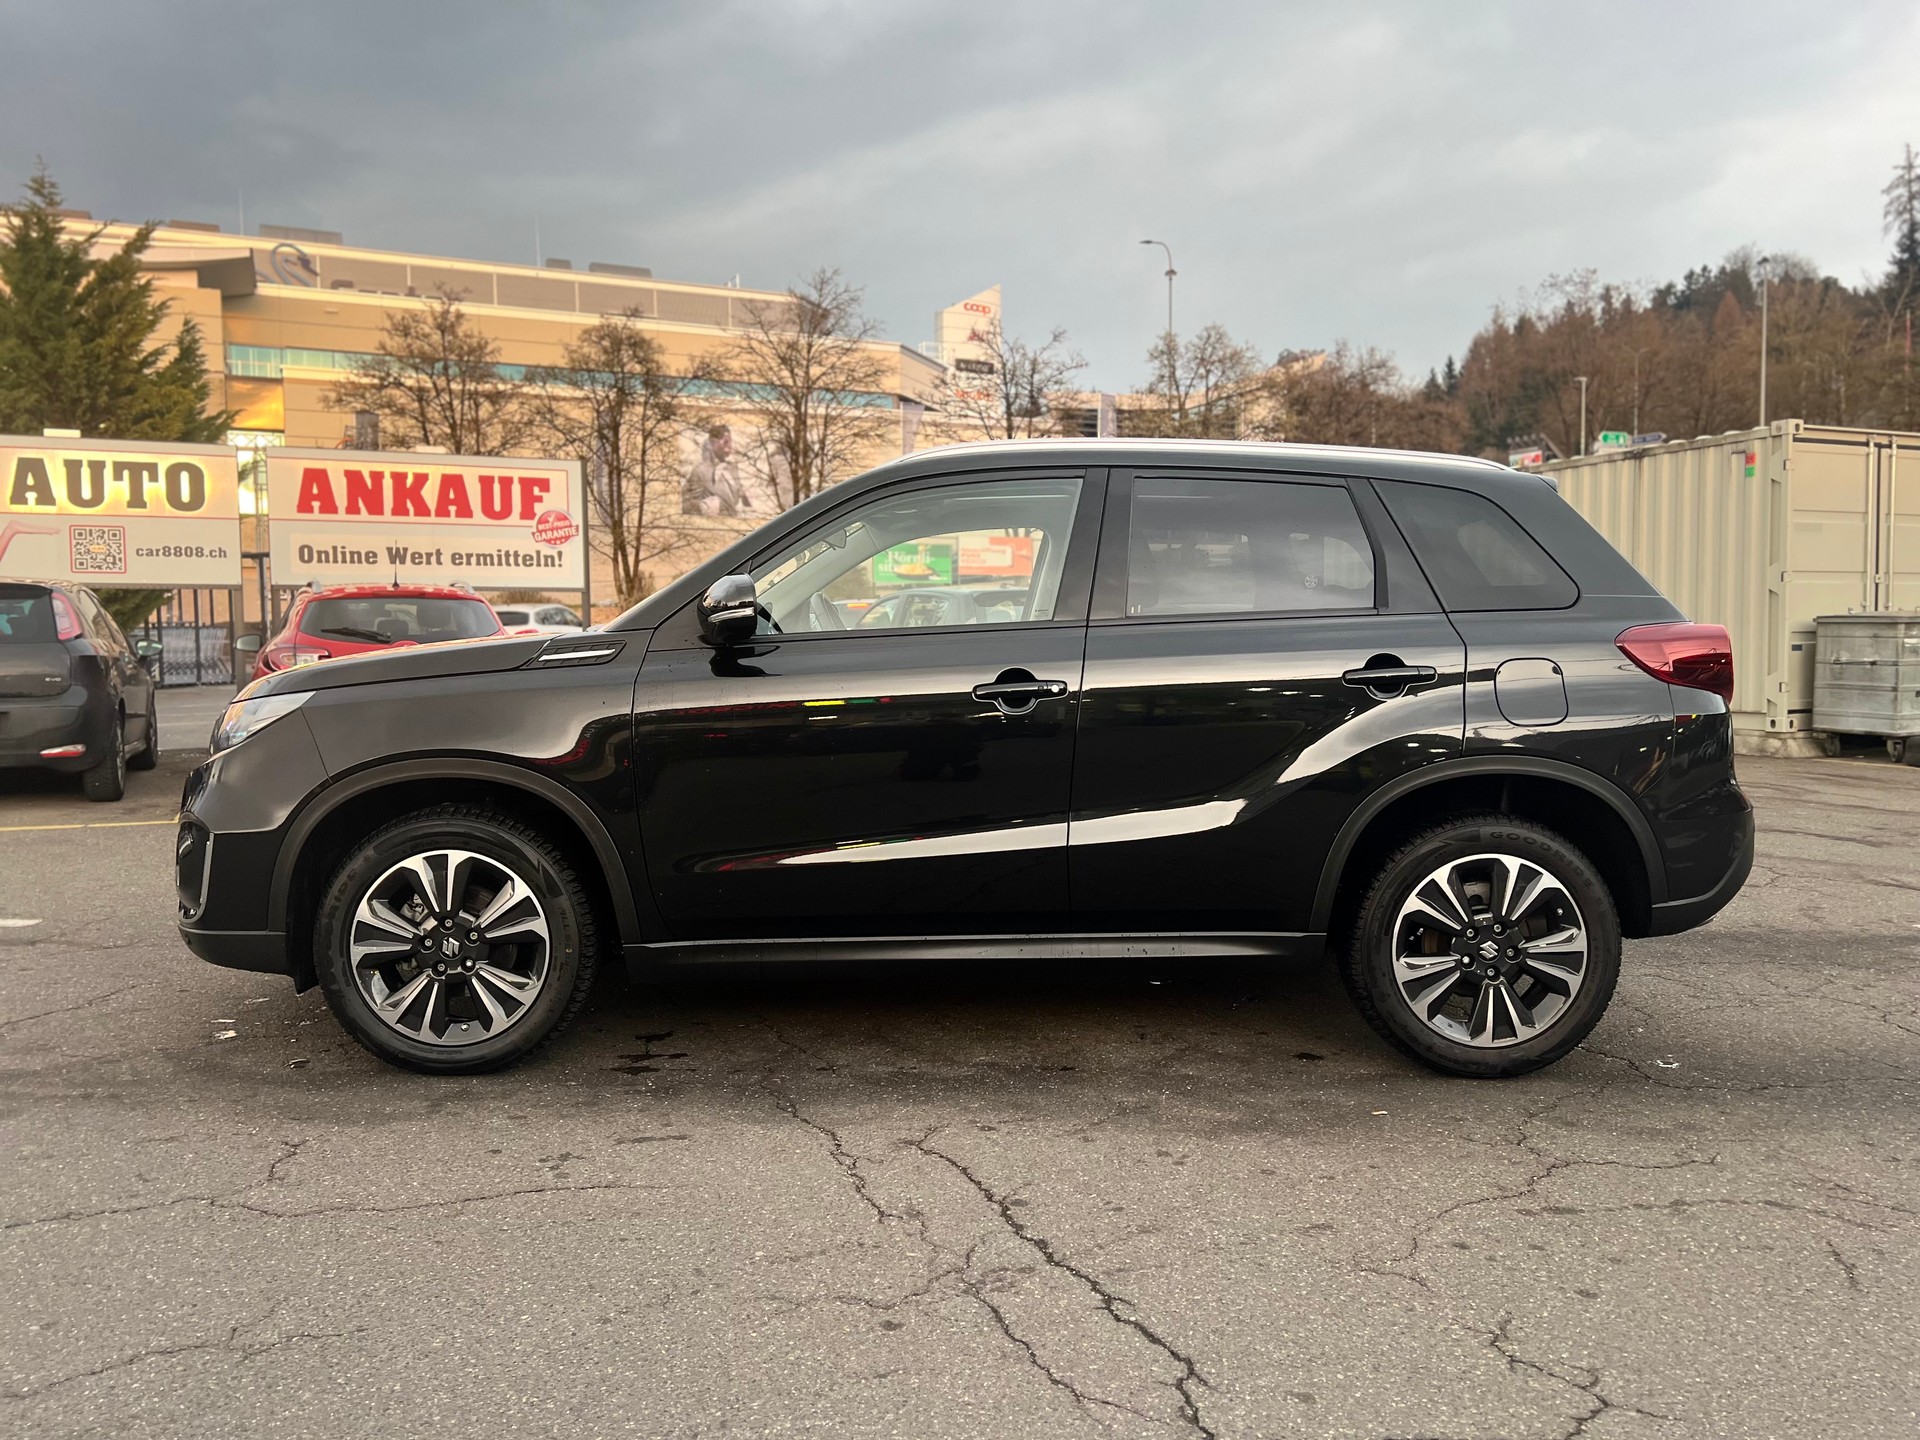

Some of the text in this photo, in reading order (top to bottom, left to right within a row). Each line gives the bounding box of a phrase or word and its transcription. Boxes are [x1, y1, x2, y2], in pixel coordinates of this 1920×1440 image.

[9, 457, 206, 512] AUTO
[296, 467, 551, 521] ANKAUF
[534, 526, 578, 541] GARANTIE
[538, 520, 570, 531] BEST-PREIS
[136, 546, 228, 558] car8808.ch
[298, 544, 563, 568] Online Wert ermitteln!
